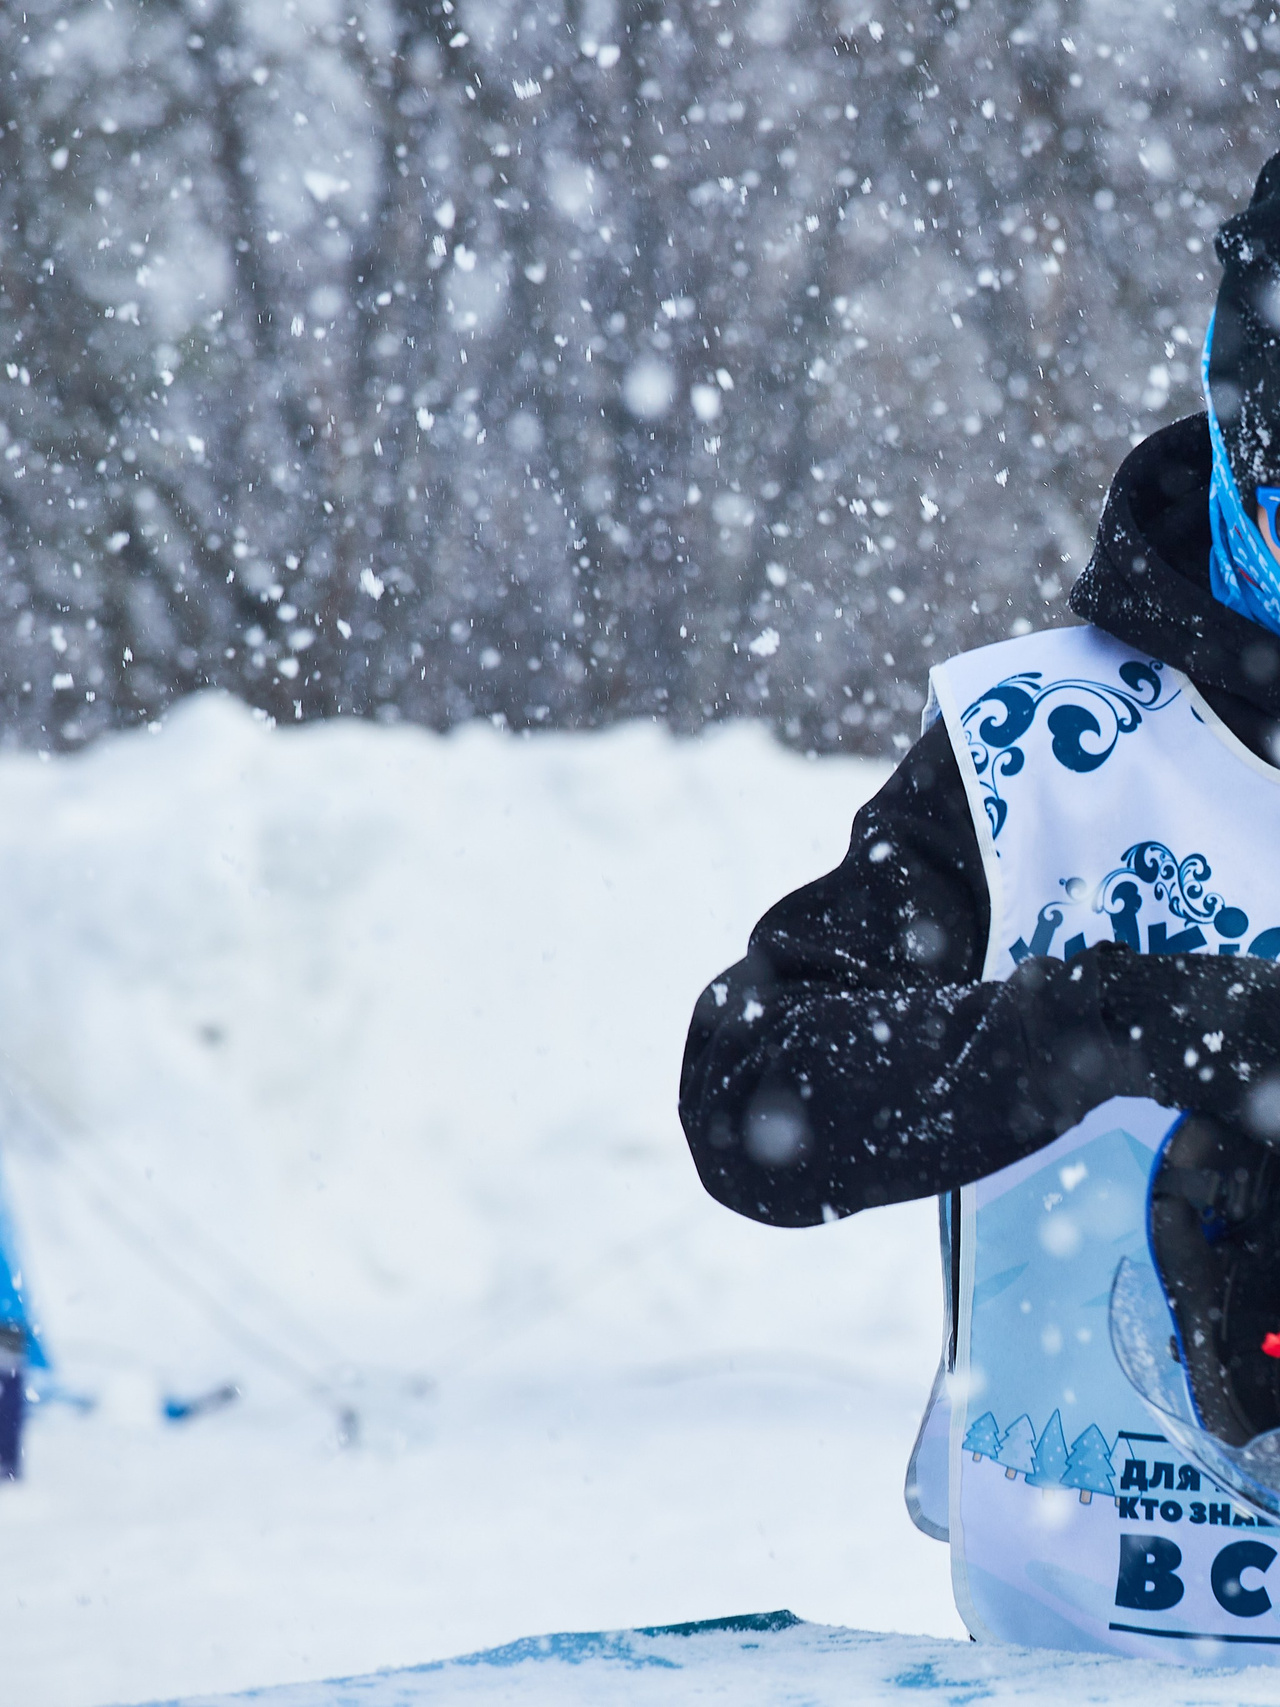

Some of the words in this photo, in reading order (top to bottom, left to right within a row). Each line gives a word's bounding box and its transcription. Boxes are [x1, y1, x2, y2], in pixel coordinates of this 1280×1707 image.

[1120, 1459, 1201, 1492] ДЛЯ
[1119, 1496, 1183, 1523] КТО
[1115, 1534, 1185, 1611] В
